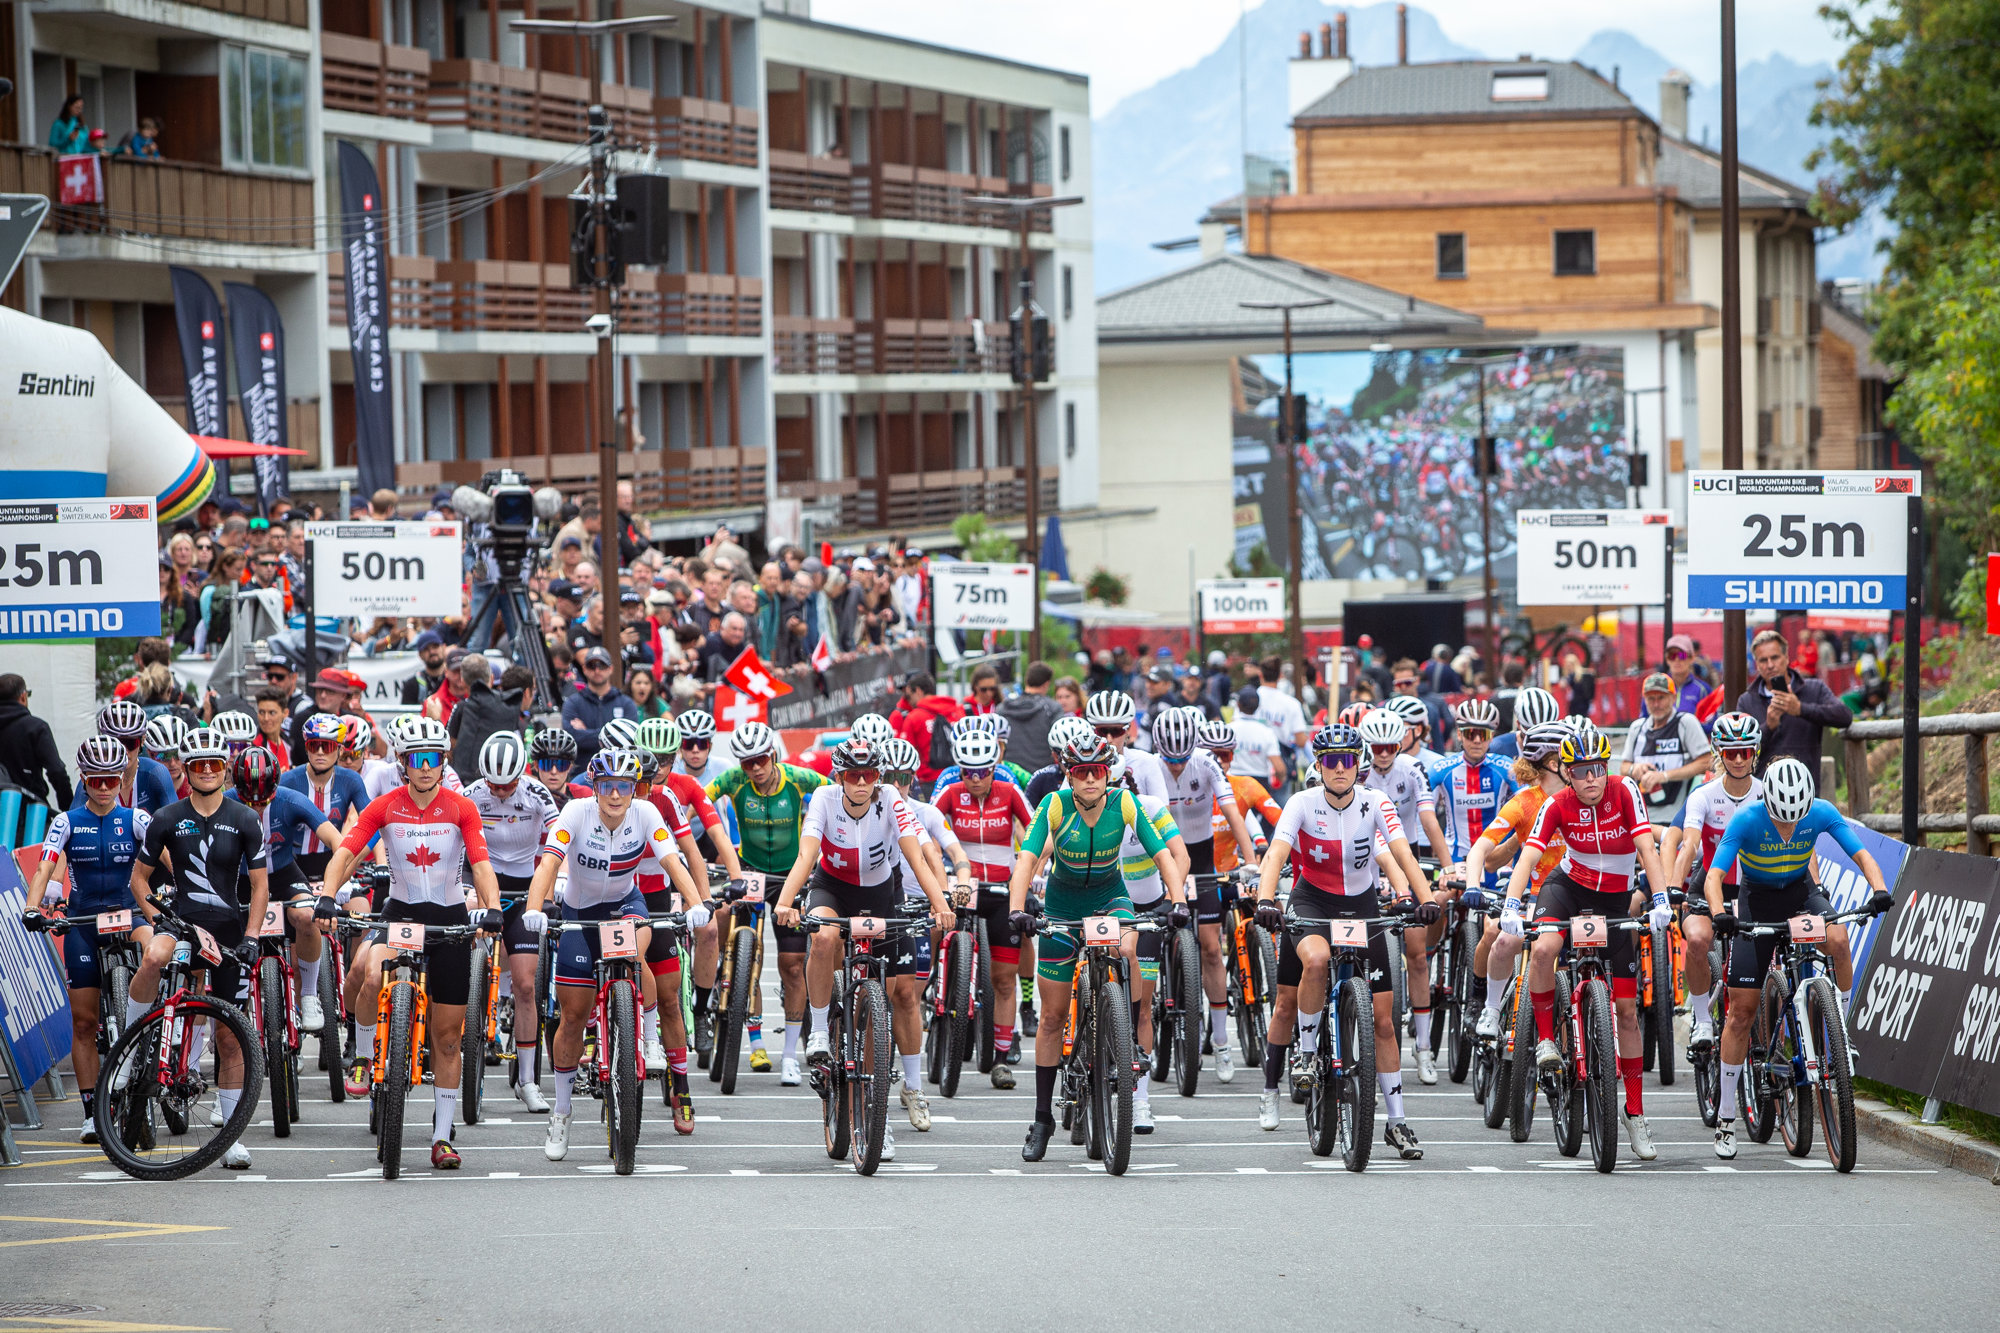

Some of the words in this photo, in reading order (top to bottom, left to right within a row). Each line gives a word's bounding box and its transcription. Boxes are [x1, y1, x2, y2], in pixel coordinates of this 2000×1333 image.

[18, 372, 95, 397] Santini
[1701, 479, 1733, 491] UCI
[1526, 516, 1548, 525] UCI
[313, 527, 335, 536] UCI
[1743, 514, 1865, 558] 25m
[1554, 540, 1637, 568] 50m
[341, 552, 424, 581] 50m
[954, 584, 1007, 603] 75m
[1725, 580, 1883, 603] SHIMANO
[1214, 597, 1268, 612] 100m
[1660, 742, 1677, 750] UCI
[744, 817, 794, 826] BRASIL
[955, 817, 1009, 829] AUSTRIA
[49, 820, 64, 843] CIC
[73, 826, 98, 834] BMC
[1568, 826, 1628, 842] AUSTRIA
[111, 843, 132, 851] CIC
[1058, 846, 1087, 858] SOUTH
[1760, 840, 1811, 852] SWEDEN
[1354, 837, 1371, 870] SUI
[577, 853, 608, 871] GBR
[106, 914, 121, 924] 11
[862, 918, 874, 931] 4
[1801, 919, 1814, 933] 3
[400, 927, 412, 939] 8
[1096, 922, 1109, 935] 6
[1343, 926, 1354, 938] 7
[1583, 922, 1595, 937] 9
[1890, 889, 1986, 972] OCHSNER
[612, 930, 625, 946] 5
[1856, 963, 1933, 1042] SPORT
